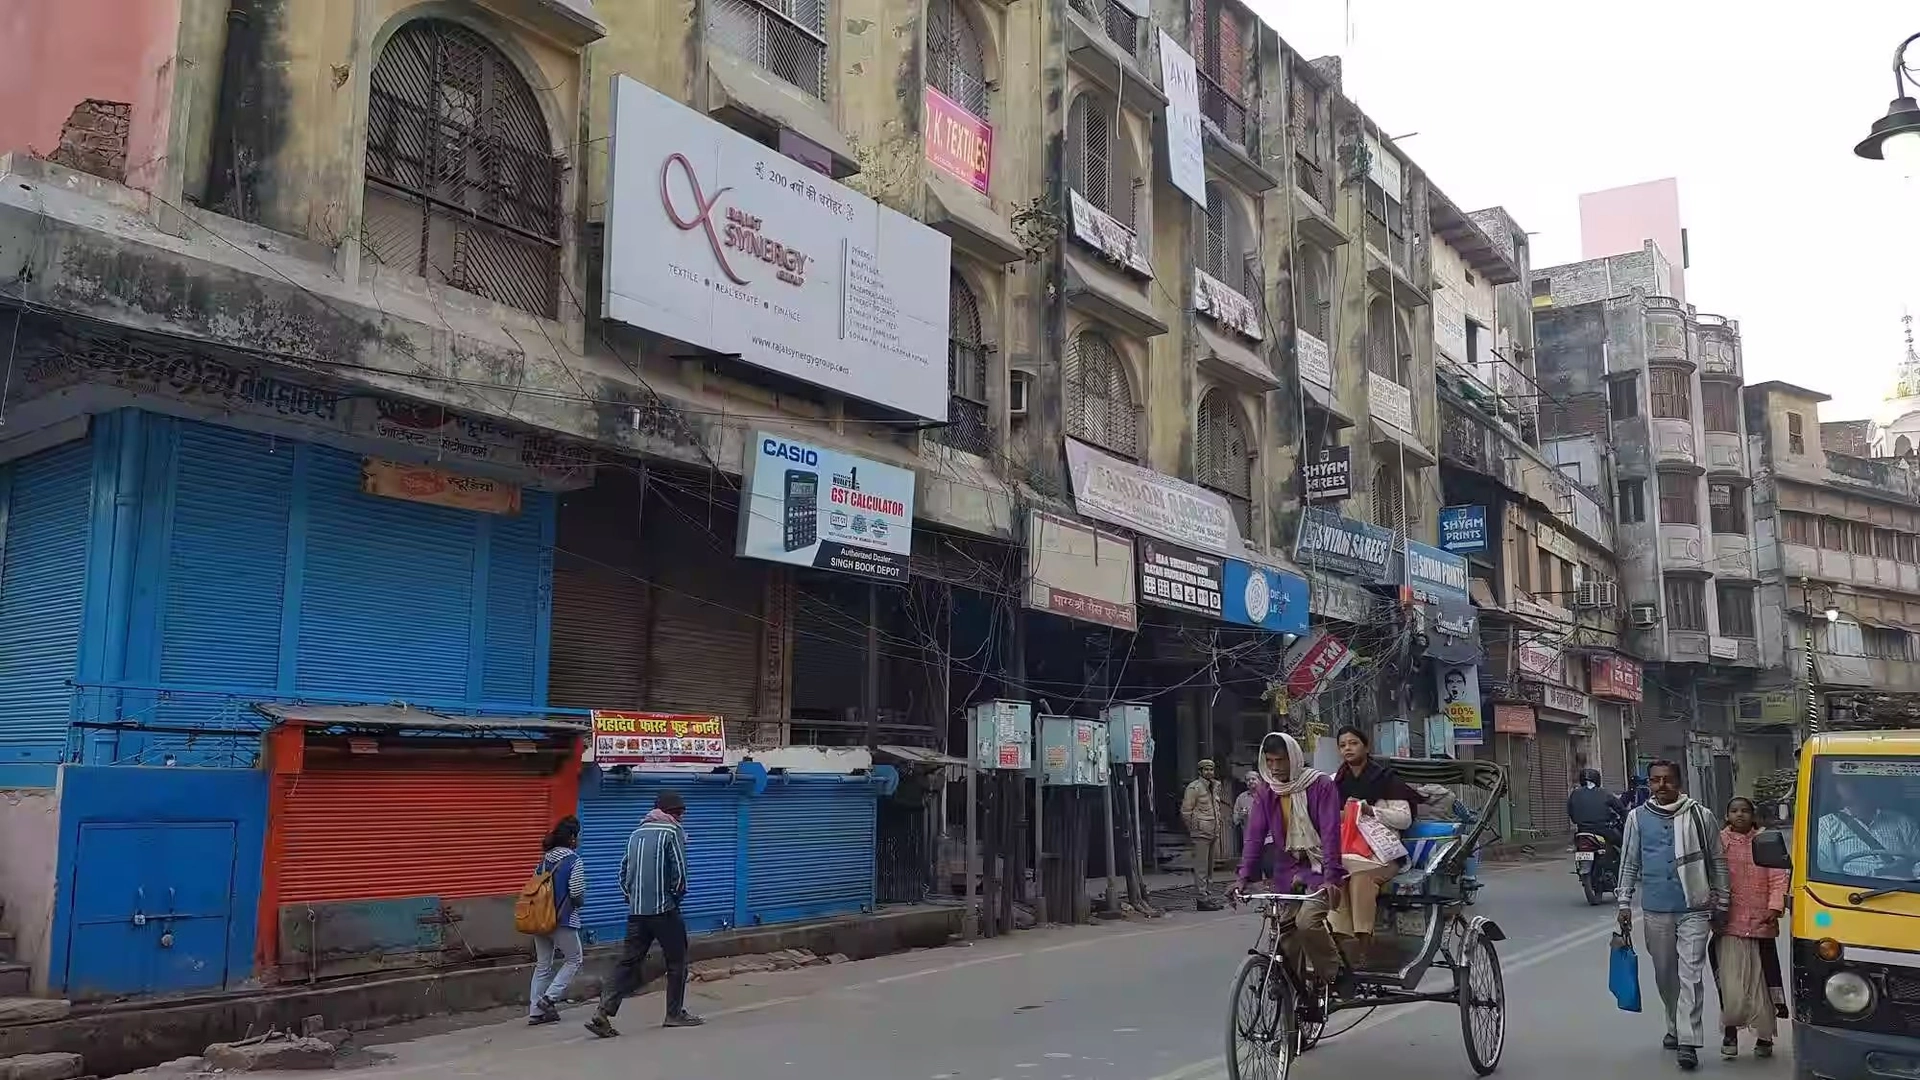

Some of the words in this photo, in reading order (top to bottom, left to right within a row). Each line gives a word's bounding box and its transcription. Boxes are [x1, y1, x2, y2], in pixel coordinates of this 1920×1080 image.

[947, 116, 988, 173] TEXTILES
[769, 170, 788, 188] 200
[806, 185, 817, 202] की
[724, 223, 808, 275] SYNERGY
[668, 263, 699, 283] TEXTILE
[715, 283, 734, 298] REAL
[734, 289, 759, 306] ESTATE
[774, 305, 801, 323] FINANCE
[763, 439, 818, 466] CASIO
[1303, 460, 1348, 477] SHYAM
[1306, 475, 1346, 489] SAREES
[831, 487, 850, 504] GST
[850, 492, 904, 517] CALCULATOR
[1443, 517, 1483, 531] SHYAM
[1446, 529, 1481, 541] PRINTS
[841, 547, 872, 561] Authorized
[873, 553, 892, 563] Dealer
[1315, 523, 1352, 556] SHYAM
[1351, 534, 1387, 565] SAREES
[830, 557, 854, 569] SINGH
[855, 561, 877, 573] BOOK
[877, 565, 900, 577] DEPOT
[1419, 554, 1441, 583] SHYAM
[1442, 562, 1465, 590] PRINTS
[1310, 640, 1342, 679] ATM
[595, 714, 636, 732] महादेव
[638, 718, 668, 733] फास्ट
